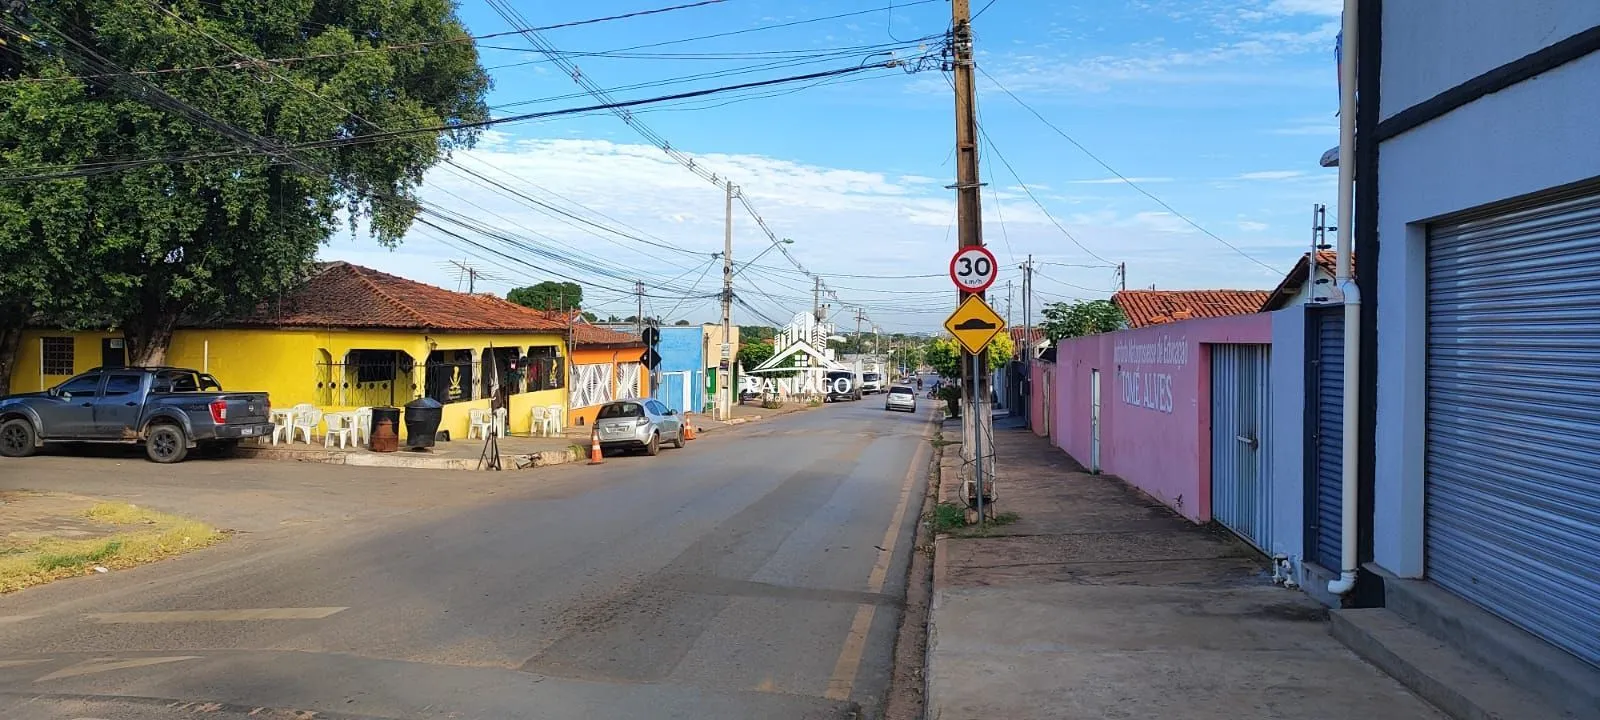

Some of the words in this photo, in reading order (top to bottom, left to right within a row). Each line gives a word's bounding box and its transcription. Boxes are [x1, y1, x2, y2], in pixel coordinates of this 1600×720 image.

[958, 257, 991, 276] 30
[1157, 336, 1163, 364] de
[1163, 335, 1188, 369] Educação
[1122, 366, 1141, 406] TOMÉ
[1143, 372, 1173, 413] ALVES
